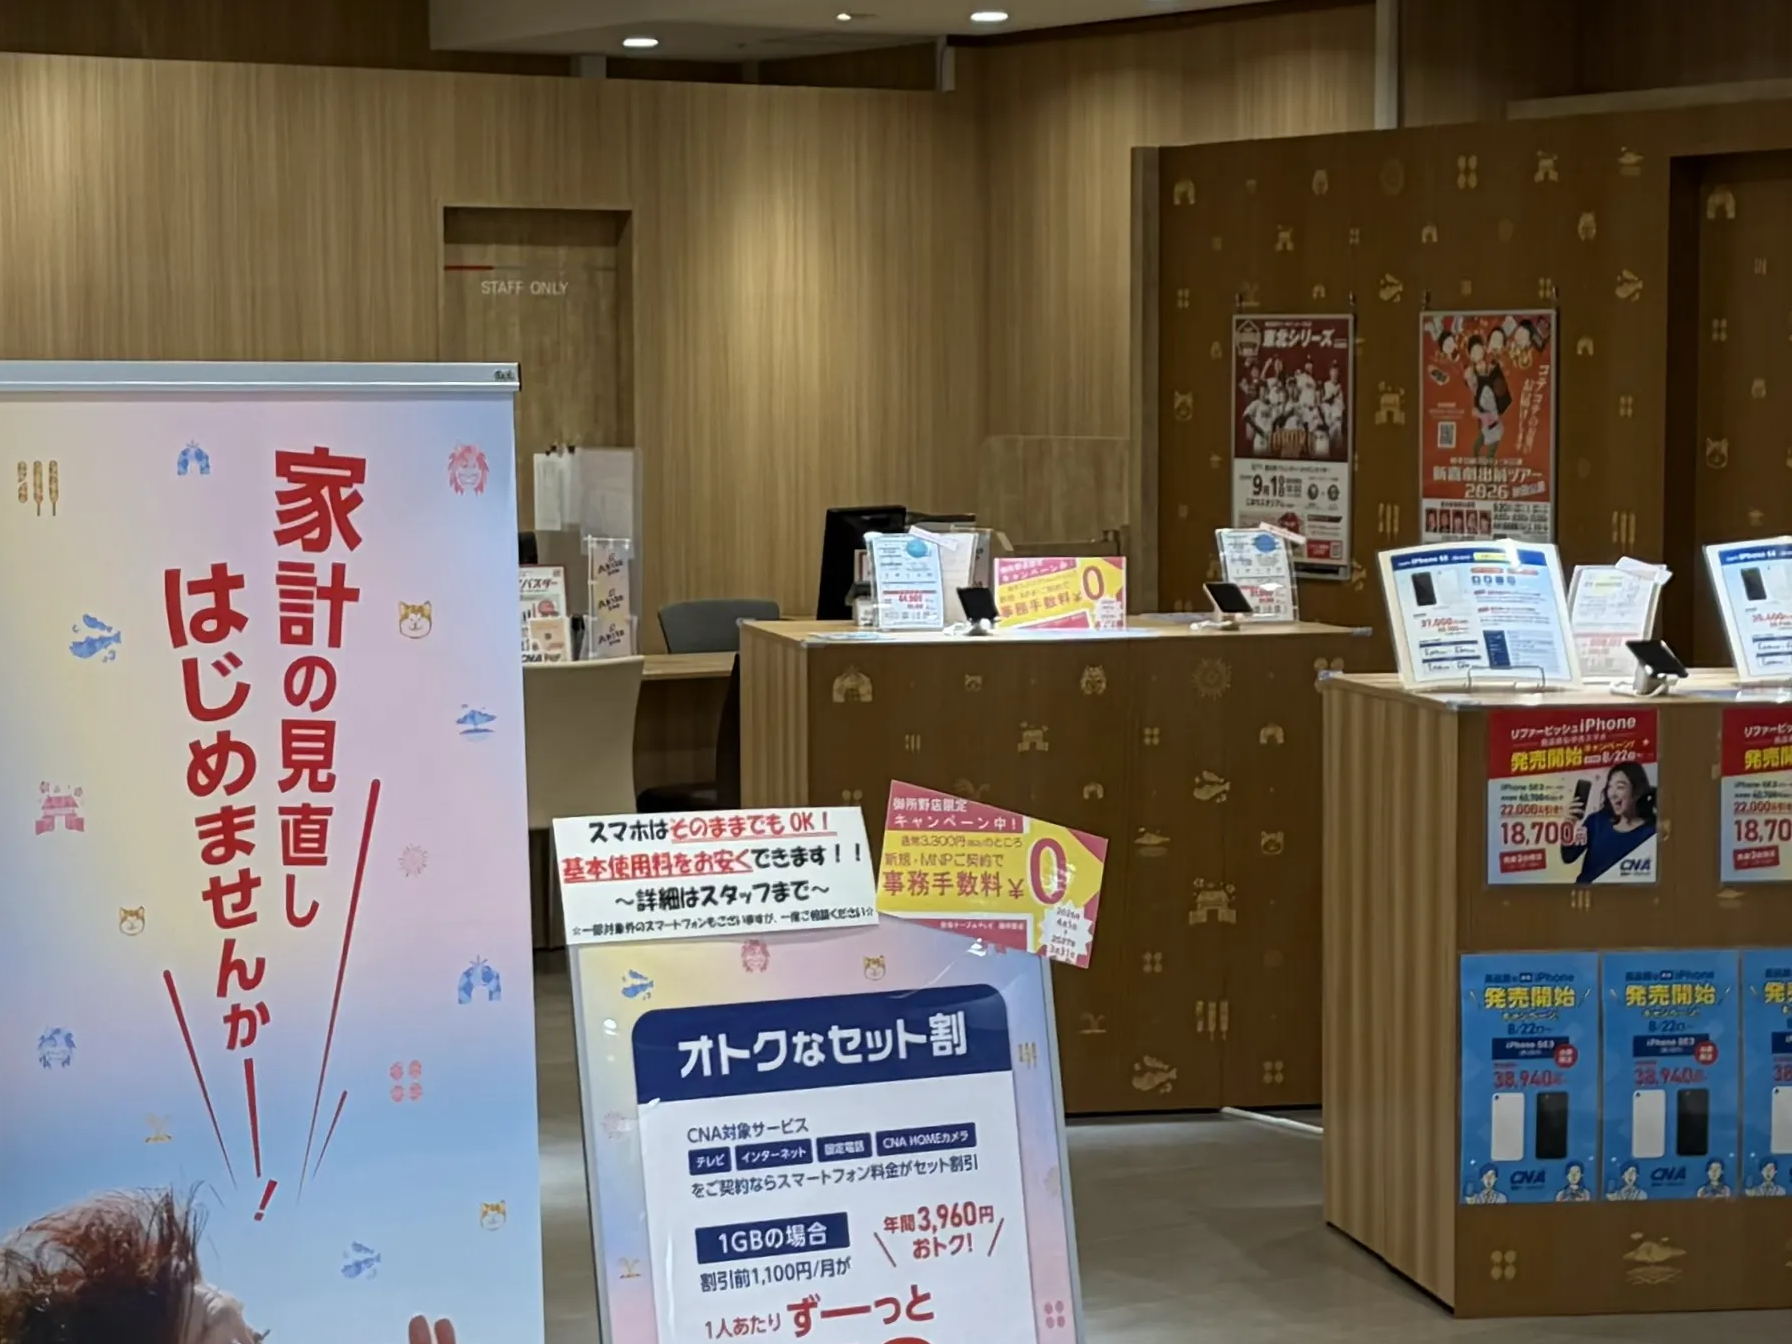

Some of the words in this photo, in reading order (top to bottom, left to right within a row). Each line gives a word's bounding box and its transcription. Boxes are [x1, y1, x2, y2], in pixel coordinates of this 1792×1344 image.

[481, 280, 524, 295] STAFF
[529, 280, 569, 295] ONLY
[1464, 483, 1509, 499] 2026
[1082, 565, 1105, 601] 0
[272, 445, 367, 929] 家計の見直し
[1510, 747, 1583, 773] 発売開始
[894, 815, 1018, 831] キャンペーン中!
[882, 871, 1003, 898] 事務手数料
[1007, 878, 1025, 900] ¥
[1029, 837, 1067, 905] 0
[1619, 859, 1652, 872] CNA
[1484, 985, 1576, 1009] 発売開始
[1625, 983, 1717, 1007] 発売開始
[678, 1010, 969, 1079] オトクなセット割
[686, 1118, 809, 1144] CNA対象サービス
[696, 1154, 726, 1168] テレビ
[740, 1146, 807, 1164] インターネット
[823, 1139, 865, 1156] 固定電話
[882, 1137, 907, 1150] CNA
[909, 1129, 969, 1147] HOMEカメラ
[691, 1153, 979, 1199] をご契約ならスマートフォン料金がセット割引
[1510, 1170, 1546, 1185] CNA
[1650, 1167, 1687, 1182] CNA
[883, 1201, 995, 1234] 年間3,960円
[718, 1222, 828, 1254] 1GBの場合
[912, 1232, 973, 1260] おトク!
[699, 1255, 852, 1293] 割引前1,100円/月が
[704, 1312, 782, 1340] 1人あたり
[786, 1283, 935, 1338] ずーっと
